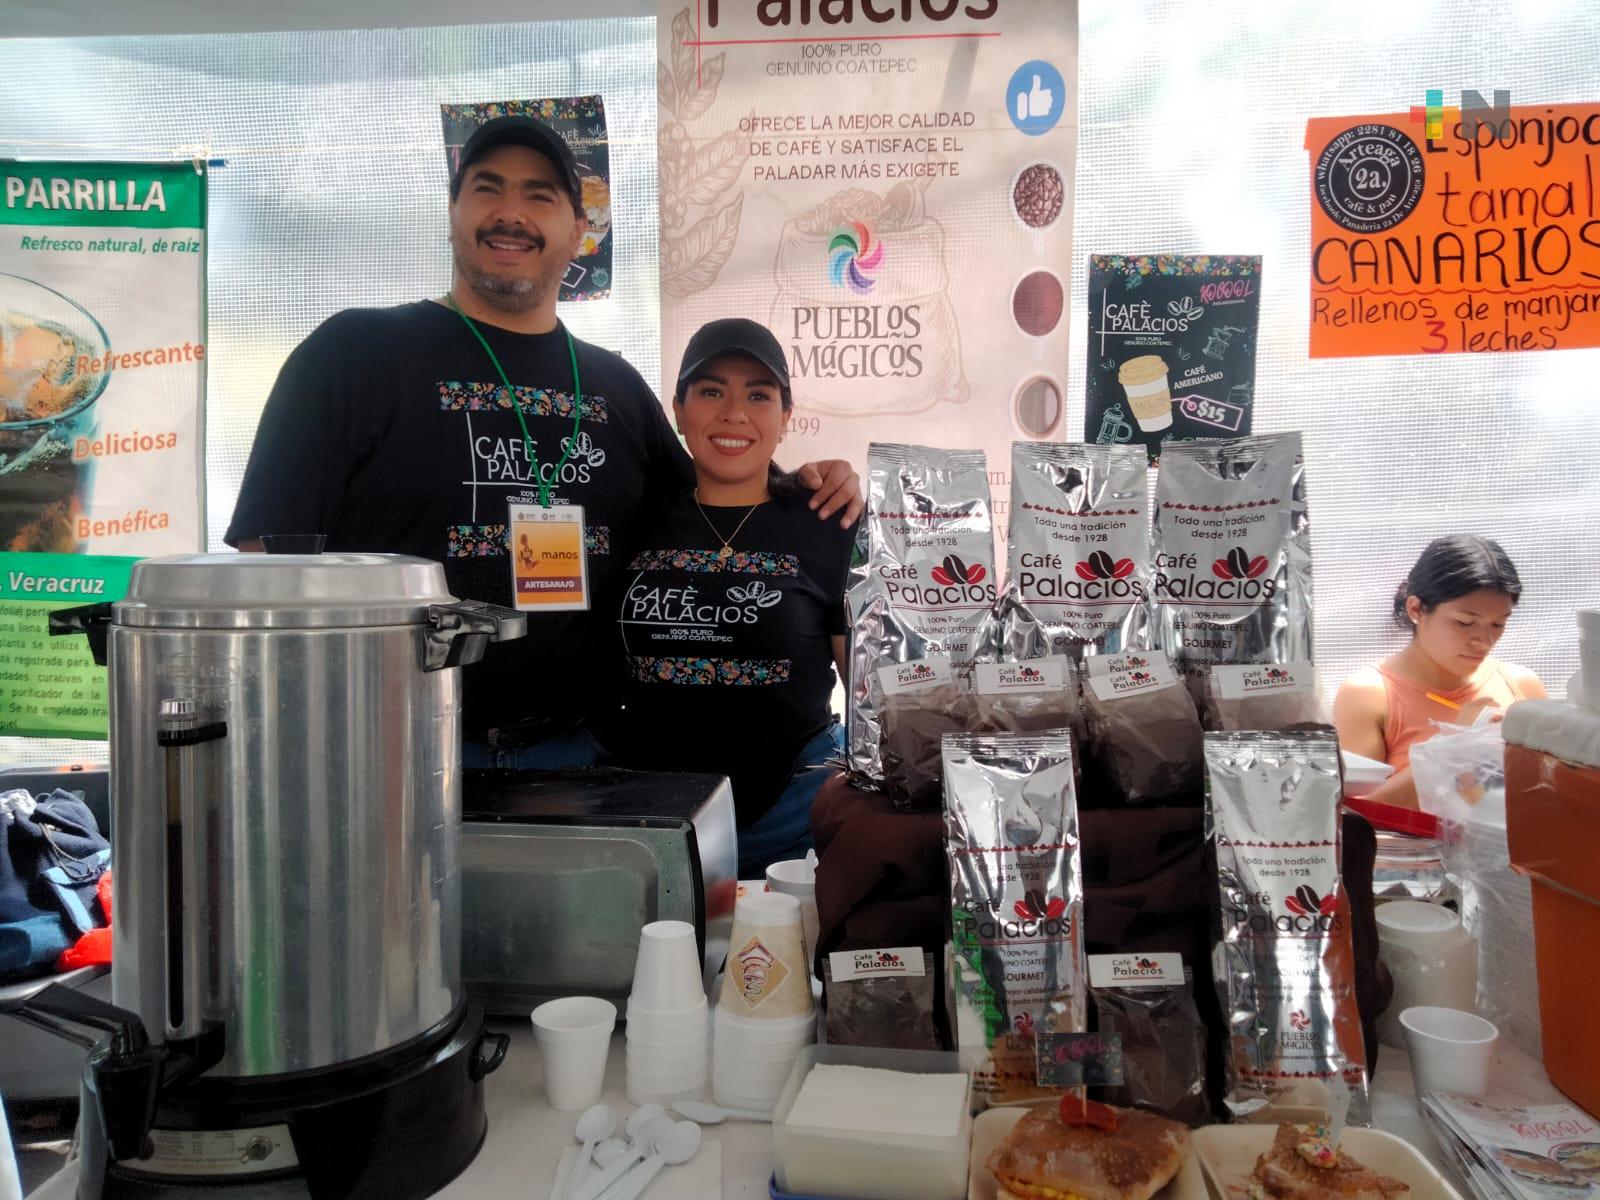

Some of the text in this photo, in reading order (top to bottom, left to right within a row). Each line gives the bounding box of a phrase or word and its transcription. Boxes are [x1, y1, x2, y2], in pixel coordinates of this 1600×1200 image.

[801, 43, 882, 58] 100% PURO
[766, 58, 917, 76] GENUINO COATEPEC
[739, 112, 975, 132] OFRECE LA MEJOR CALIDAD
[750, 136, 964, 156] DE CAFÉ Y SATISFACE EL
[1357, 125, 1385, 136] 2281
[1388, 129, 1402, 142] 81
[1403, 141, 1416, 155] 18
[1411, 157, 1422, 173] 26
[1339, 143, 1400, 172] Arteaga
[754, 160, 960, 181] PALADAR MÁS EXIGETE
[1355, 168, 1387, 190] 2a.
[6, 176, 167, 212] PARRILLA
[1366, 204, 1376, 213] &
[1379, 194, 1397, 214] pan
[20, 236, 200, 255] Refresco natural, de raíz
[1312, 219, 1600, 288] CANARIOS
[1313, 297, 1437, 328] Rellenos
[1455, 295, 1489, 321] de
[791, 304, 922, 341] PUEBLOS
[1112, 317, 1189, 332] PALACIOS
[1421, 319, 1557, 353] 3 leches
[76, 341, 205, 375] Refrescante
[1173, 372, 1224, 390] AMERICANO
[1197, 400, 1226, 423] $15
[784, 417, 821, 436] 199
[75, 431, 178, 459] Deliciosa
[487, 459, 591, 484] PALACIOS
[78, 510, 170, 539] Benéfica
[1034, 516, 1127, 531] Toda una tradición
[1174, 513, 1265, 527] Toda una tradición
[905, 537, 958, 547] desde 1928
[1052, 532, 1108, 543] desde 1928
[1191, 528, 1248, 539] desde 1928
[541, 550, 578, 560] manos
[1020, 553, 1062, 570] Café
[1155, 553, 1197, 569] Café
[879, 563, 918, 580] Café
[9, 572, 105, 594] Veracruz
[524, 580, 575, 589] ARTESANA/O
[1019, 572, 1143, 600] Palacios
[1155, 573, 1277, 600] Palacios
[884, 581, 998, 606] Palacios
[631, 601, 758, 624] PALACIOS
[1062, 610, 1104, 620] 100% Puro
[689, 635, 734, 643] COATEPEC
[925, 643, 969, 652] GOURMET
[1183, 638, 1233, 649] GOURMET
[66, 659, 90, 669] para
[896, 666, 911, 675] Café
[998, 667, 1016, 675] Café
[898, 670, 936, 683] Palacios
[999, 674, 1046, 683] Palacios
[1113, 677, 1158, 690] Palacios
[1244, 675, 1295, 687] Palacios
[9, 702, 22, 713] Se
[1265, 858, 1282, 866] una
[1259, 868, 1311, 877] desde 1928
[964, 917, 1071, 939] Palacios
[855, 961, 905, 969] Palacios
[1113, 967, 1164, 976] Palacios
